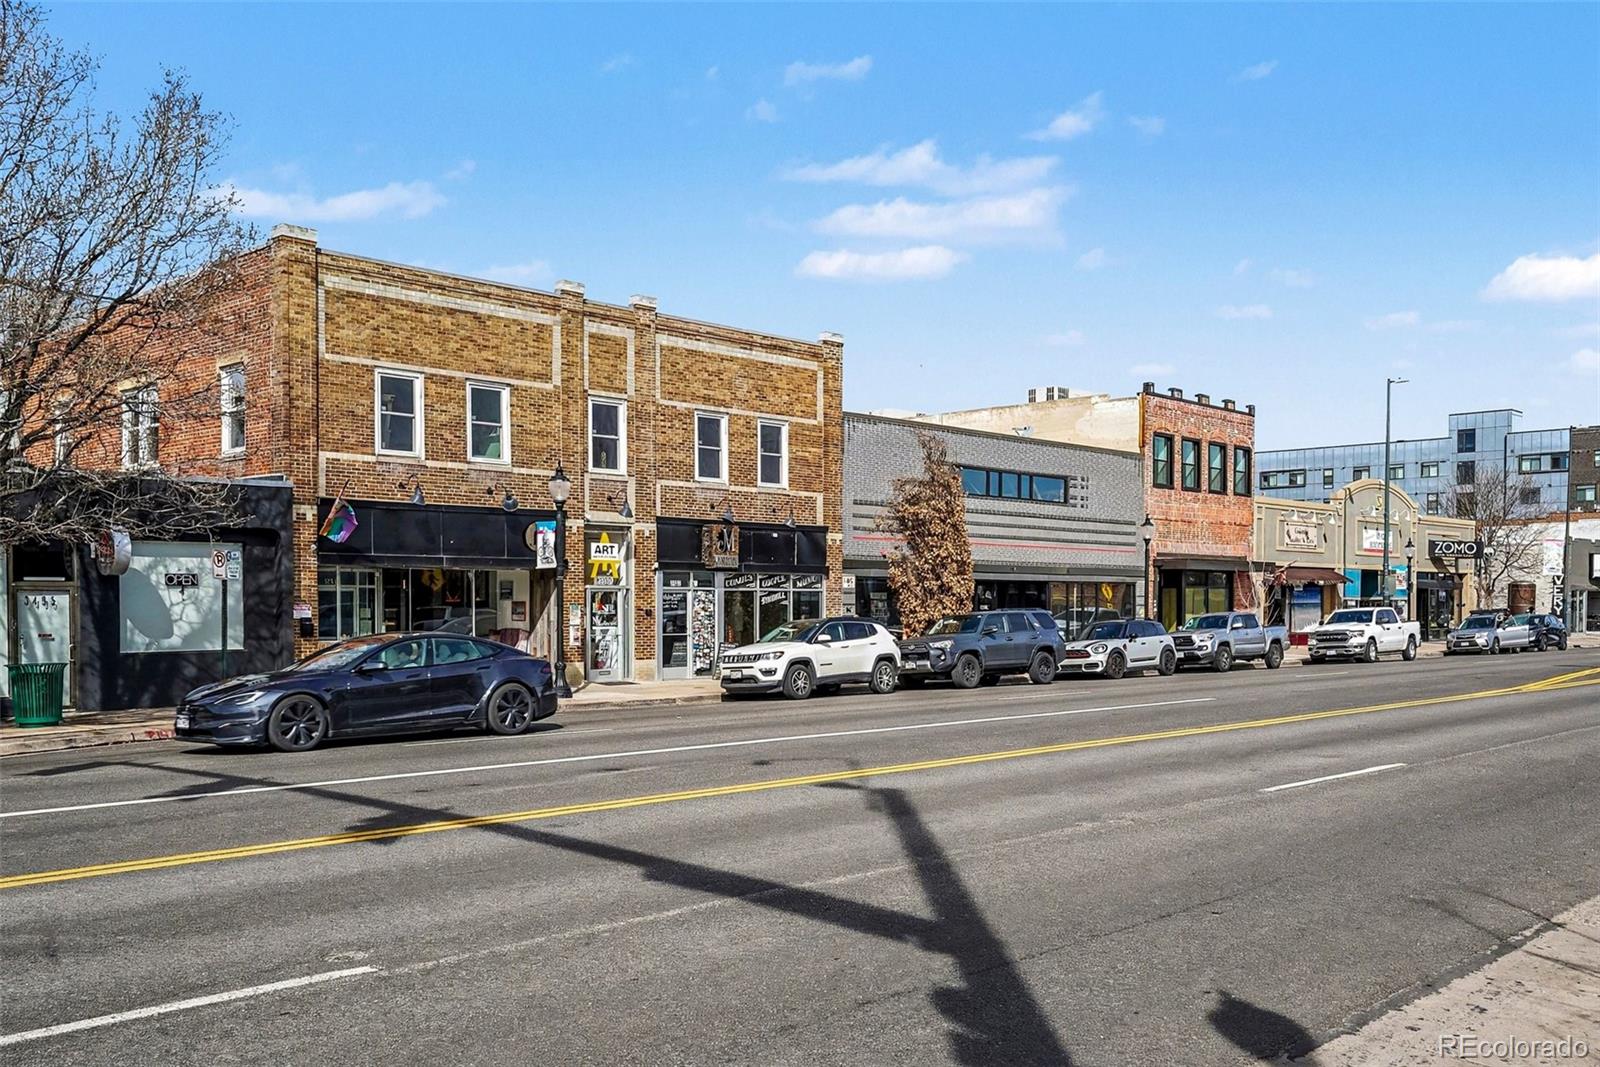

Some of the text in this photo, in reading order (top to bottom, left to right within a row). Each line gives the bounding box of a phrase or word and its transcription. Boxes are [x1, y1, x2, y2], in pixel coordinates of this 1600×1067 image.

[594, 545, 615, 554] ART
[1434, 541, 1477, 554] ZOMO
[165, 574, 198, 586] OPEN
